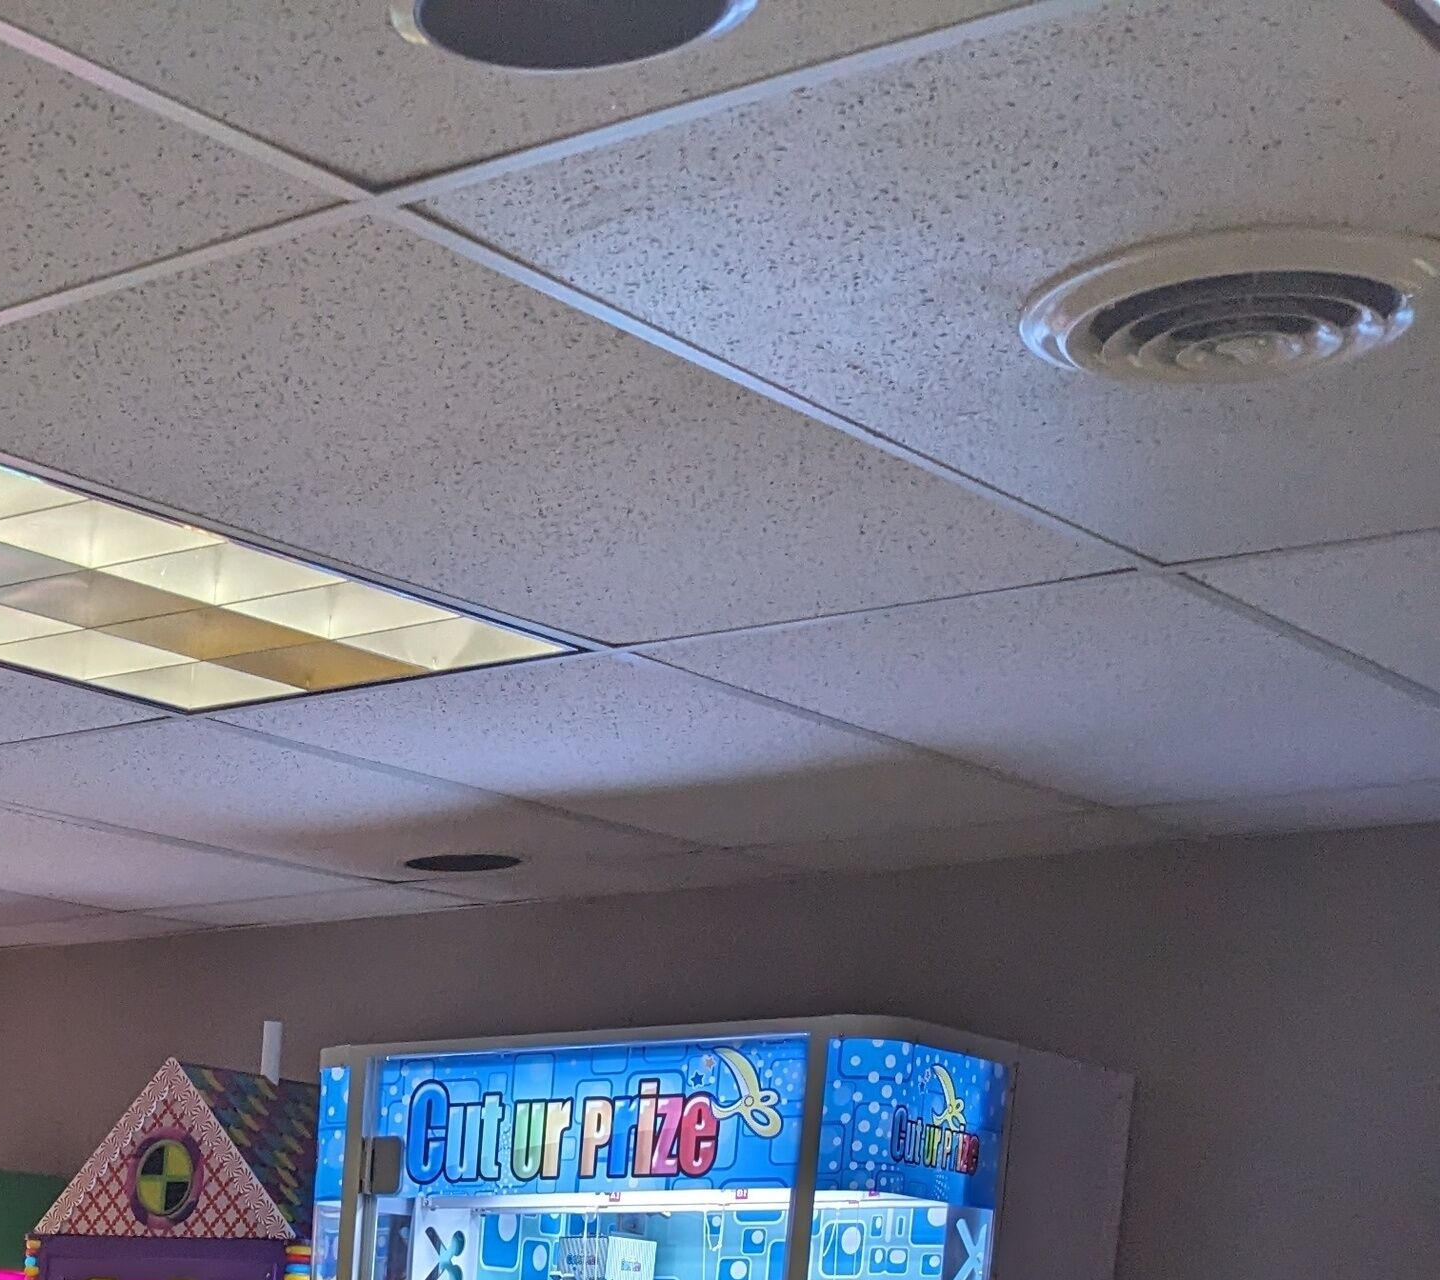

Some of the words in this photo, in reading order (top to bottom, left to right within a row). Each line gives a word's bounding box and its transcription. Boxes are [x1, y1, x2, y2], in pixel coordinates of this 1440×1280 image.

[406, 1079, 503, 1185] Cut
[511, 1097, 573, 1182] ur
[890, 1105, 923, 1164] Cut
[923, 1124, 942, 1167] ur
